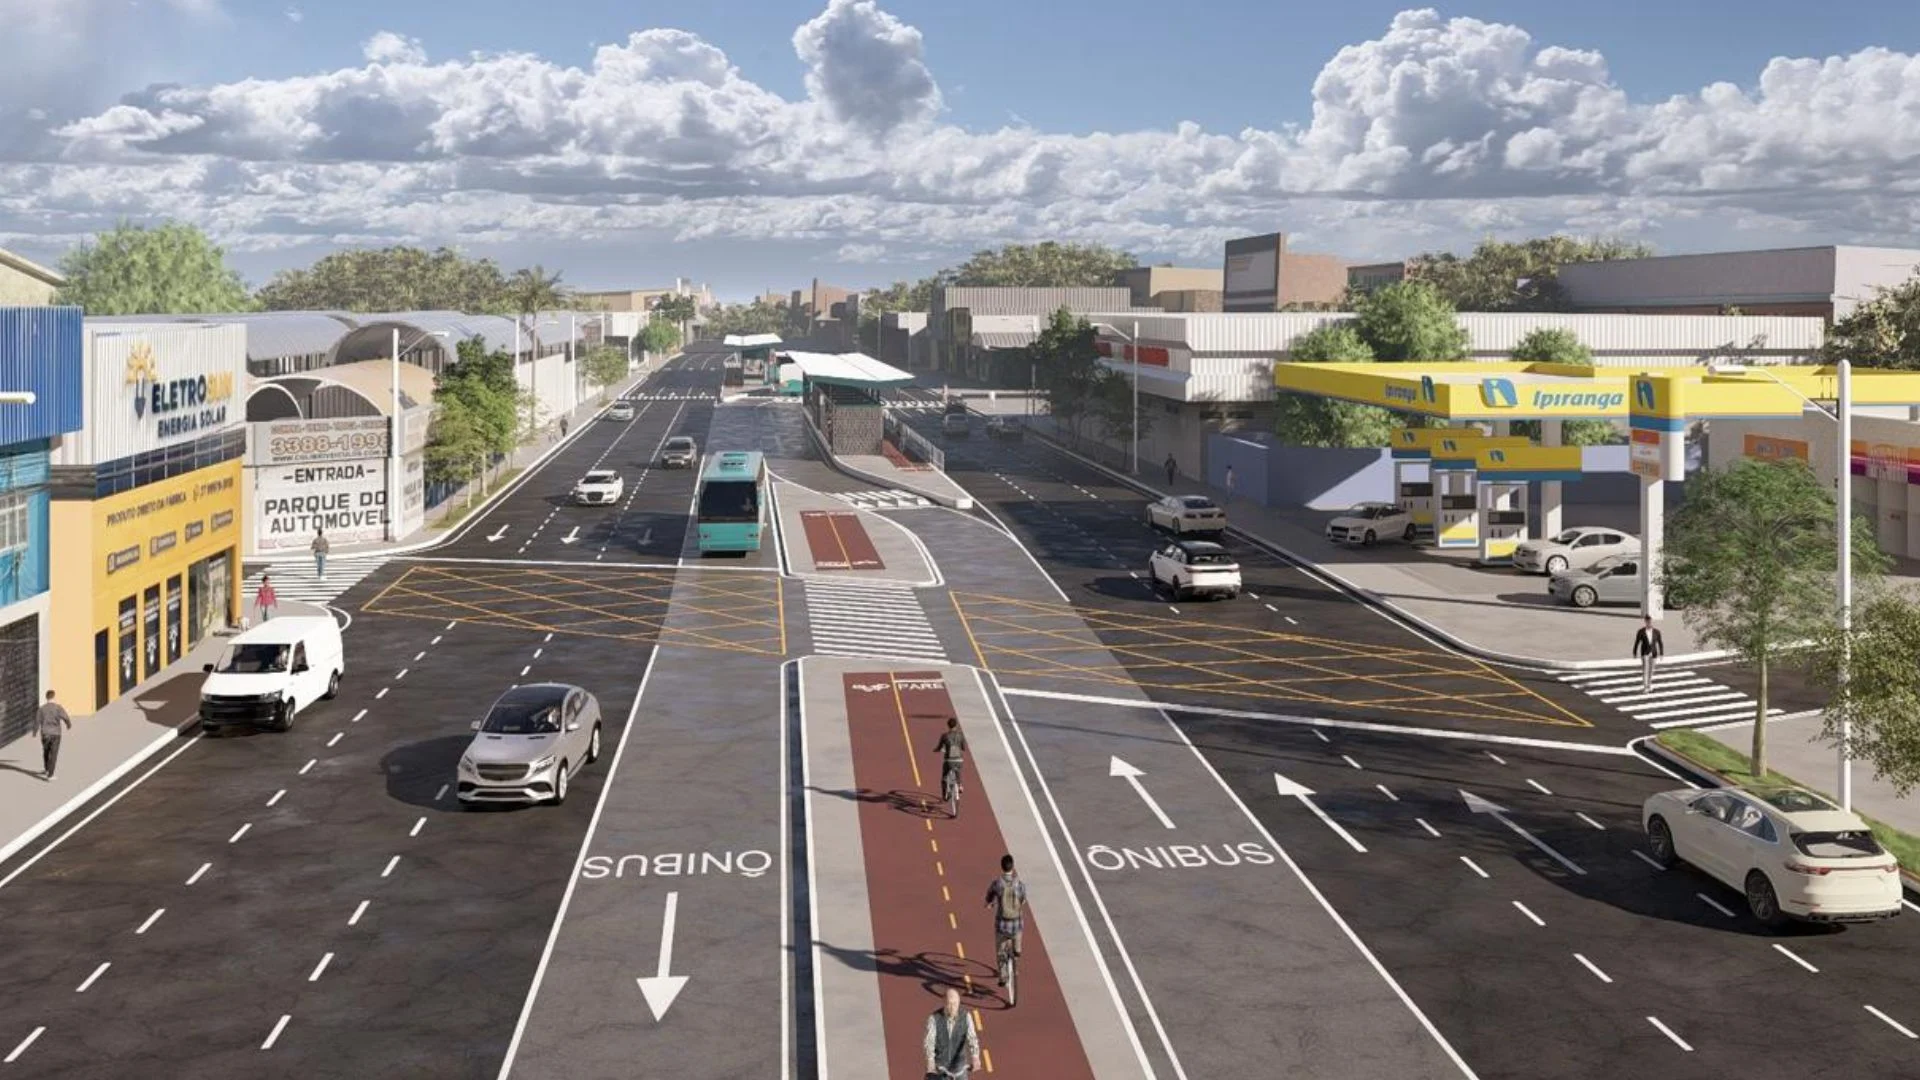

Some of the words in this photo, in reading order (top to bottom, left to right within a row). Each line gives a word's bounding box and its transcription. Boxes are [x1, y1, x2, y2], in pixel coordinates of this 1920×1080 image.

[1533, 390, 1623, 409] Ipiranga
[158, 413, 197, 438] ENERGIA
[200, 405, 226, 429] SOLAR
[265, 493, 350, 515] PARQUE
[360, 491, 387, 507] DO
[271, 510, 391, 534] AUTOMÓVEL
[898, 682, 944, 690] PARE
[582, 850, 772, 878] ÔNIBUS
[1087, 843, 1275, 871] ÔNIBUS
